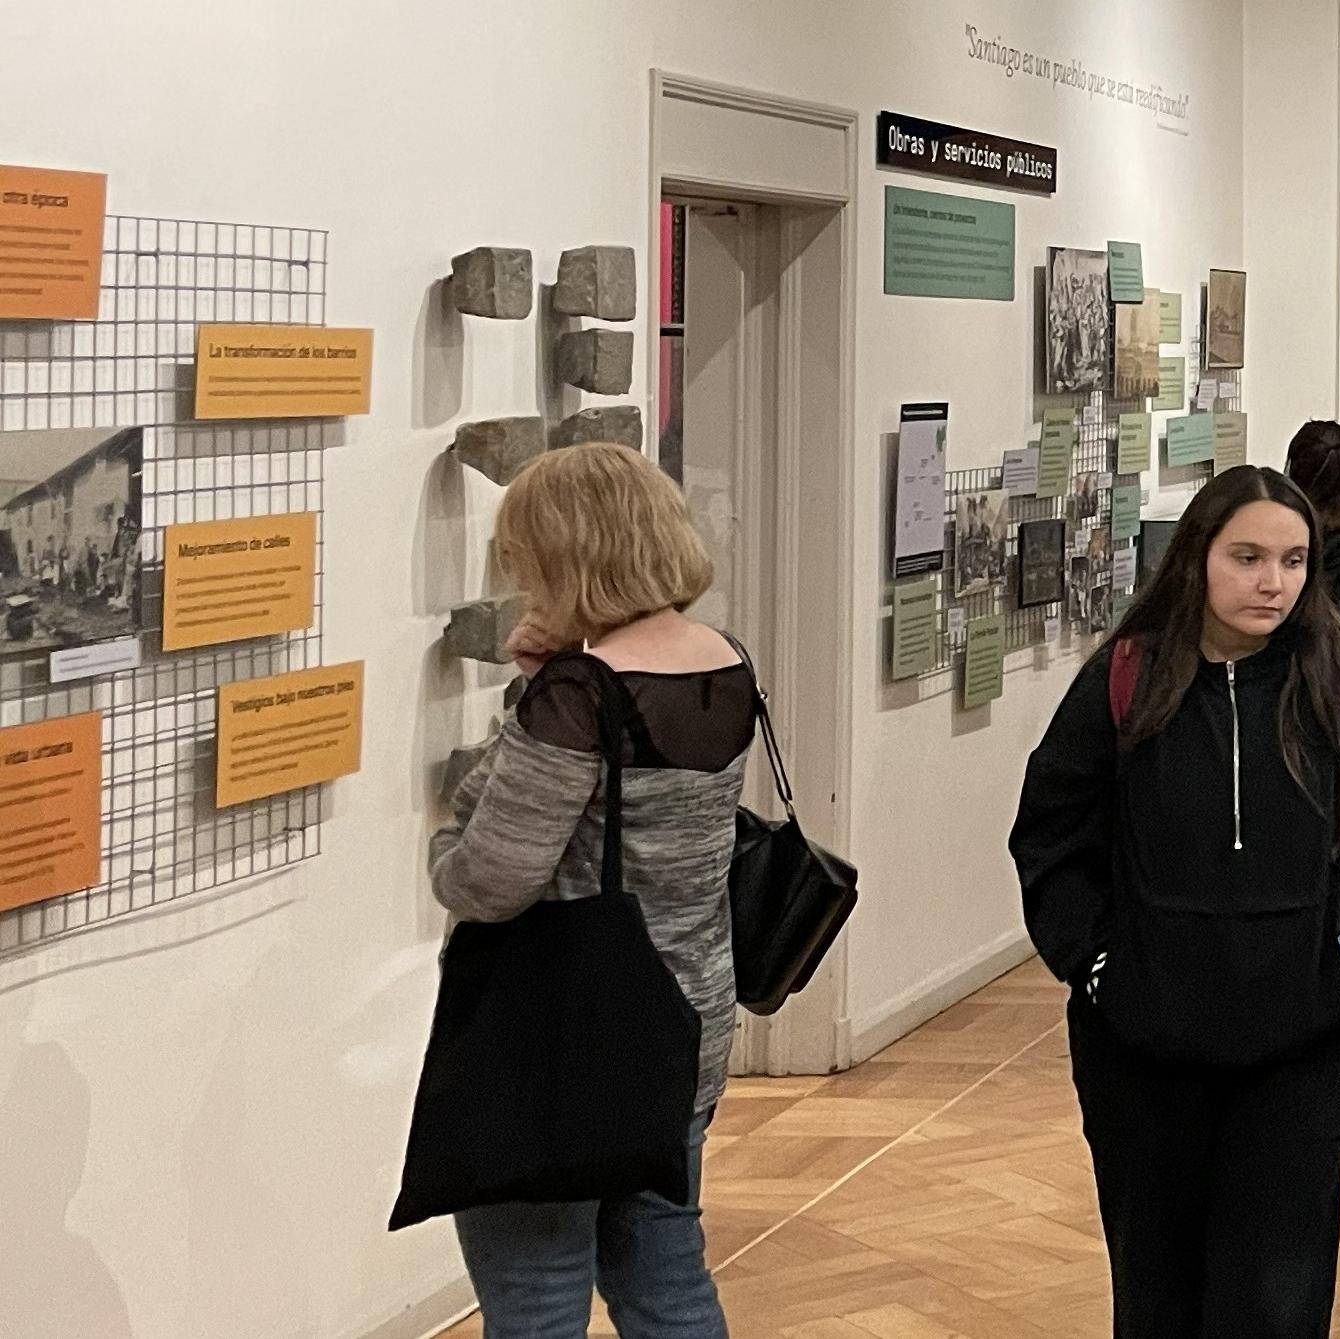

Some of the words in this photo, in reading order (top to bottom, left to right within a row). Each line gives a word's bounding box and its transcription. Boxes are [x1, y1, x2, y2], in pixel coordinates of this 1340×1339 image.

[888, 124, 925, 156] Obras
[930, 138, 940, 163] y
[944, 141, 1003, 170] servicios
[1006, 150, 1054, 180] públicos
[208, 343, 222, 358] La
[178, 540, 248, 560] Mejoramiento
[249, 537, 262, 551] de
